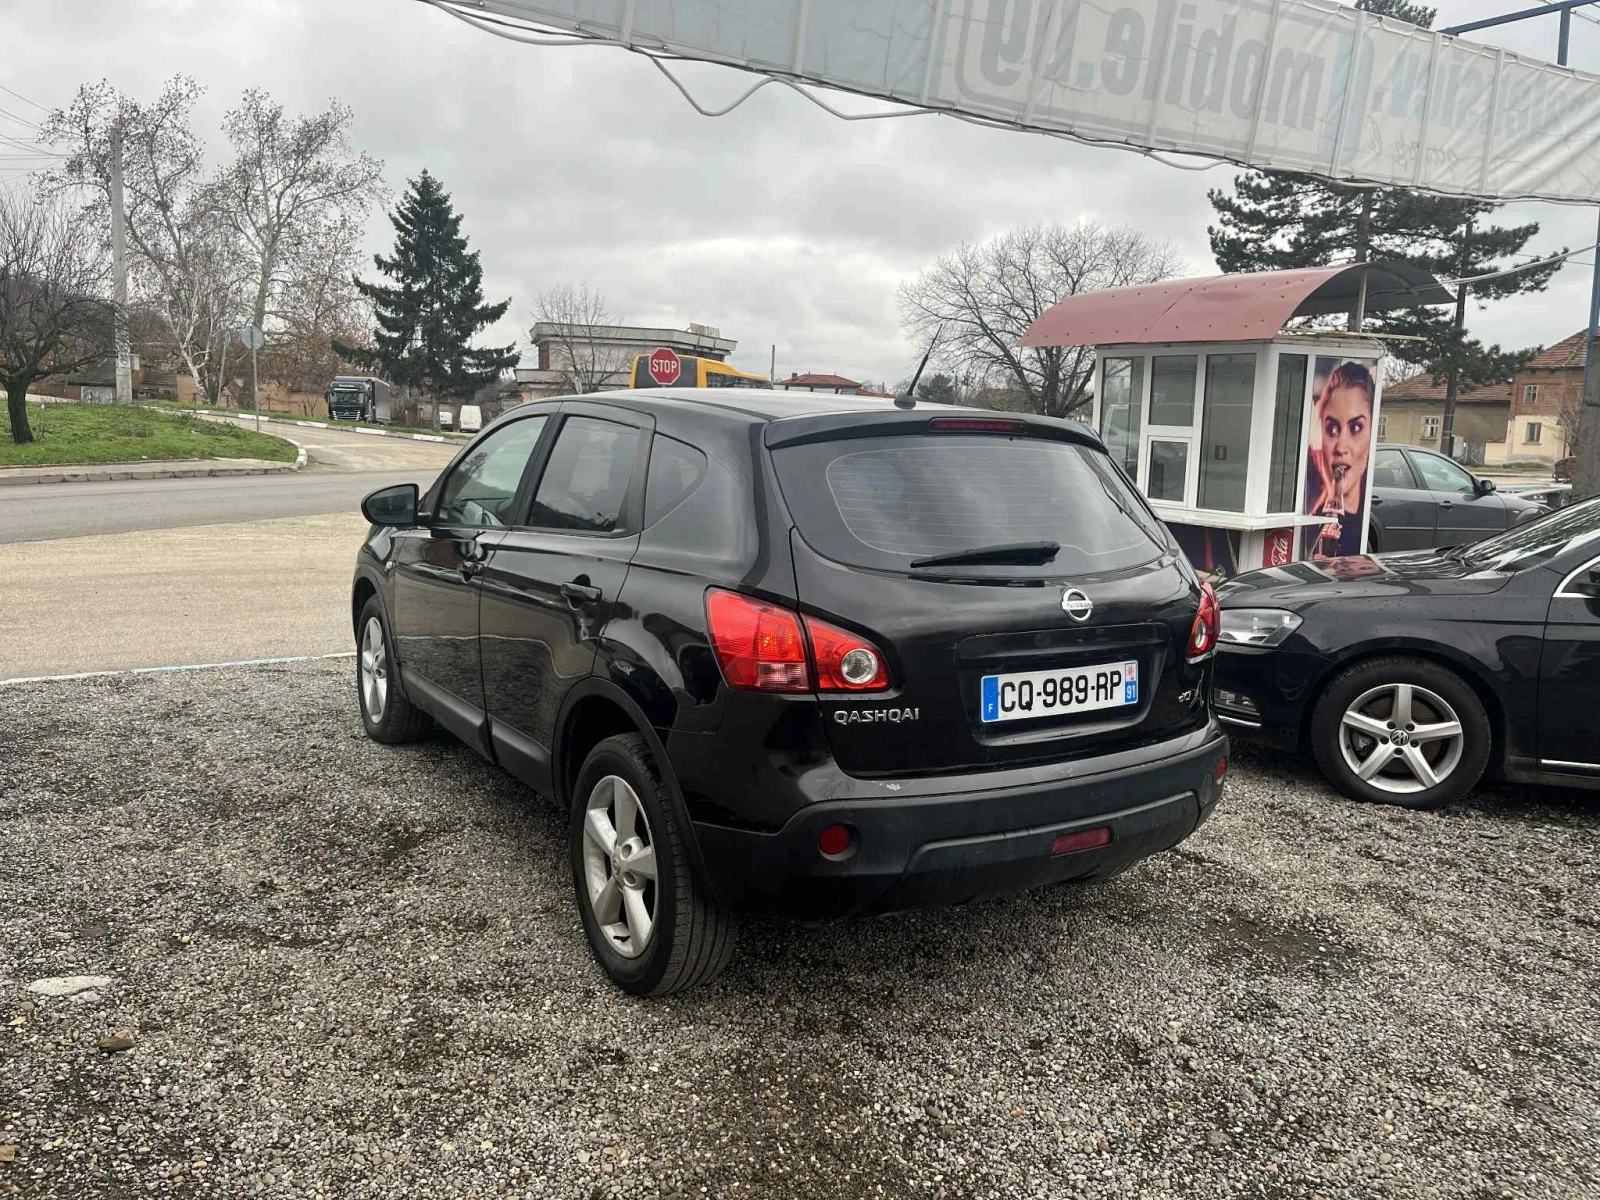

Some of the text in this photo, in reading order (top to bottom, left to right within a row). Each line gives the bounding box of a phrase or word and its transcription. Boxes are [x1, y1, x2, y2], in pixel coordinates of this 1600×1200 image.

[652, 359, 678, 374] STOP
[1066, 601, 1093, 610] NISSAN
[1000, 670, 1122, 712] CQ-989-RP
[1126, 685, 1136, 699] 91
[988, 704, 994, 713] F
[833, 708, 920, 725] QASHQAI
